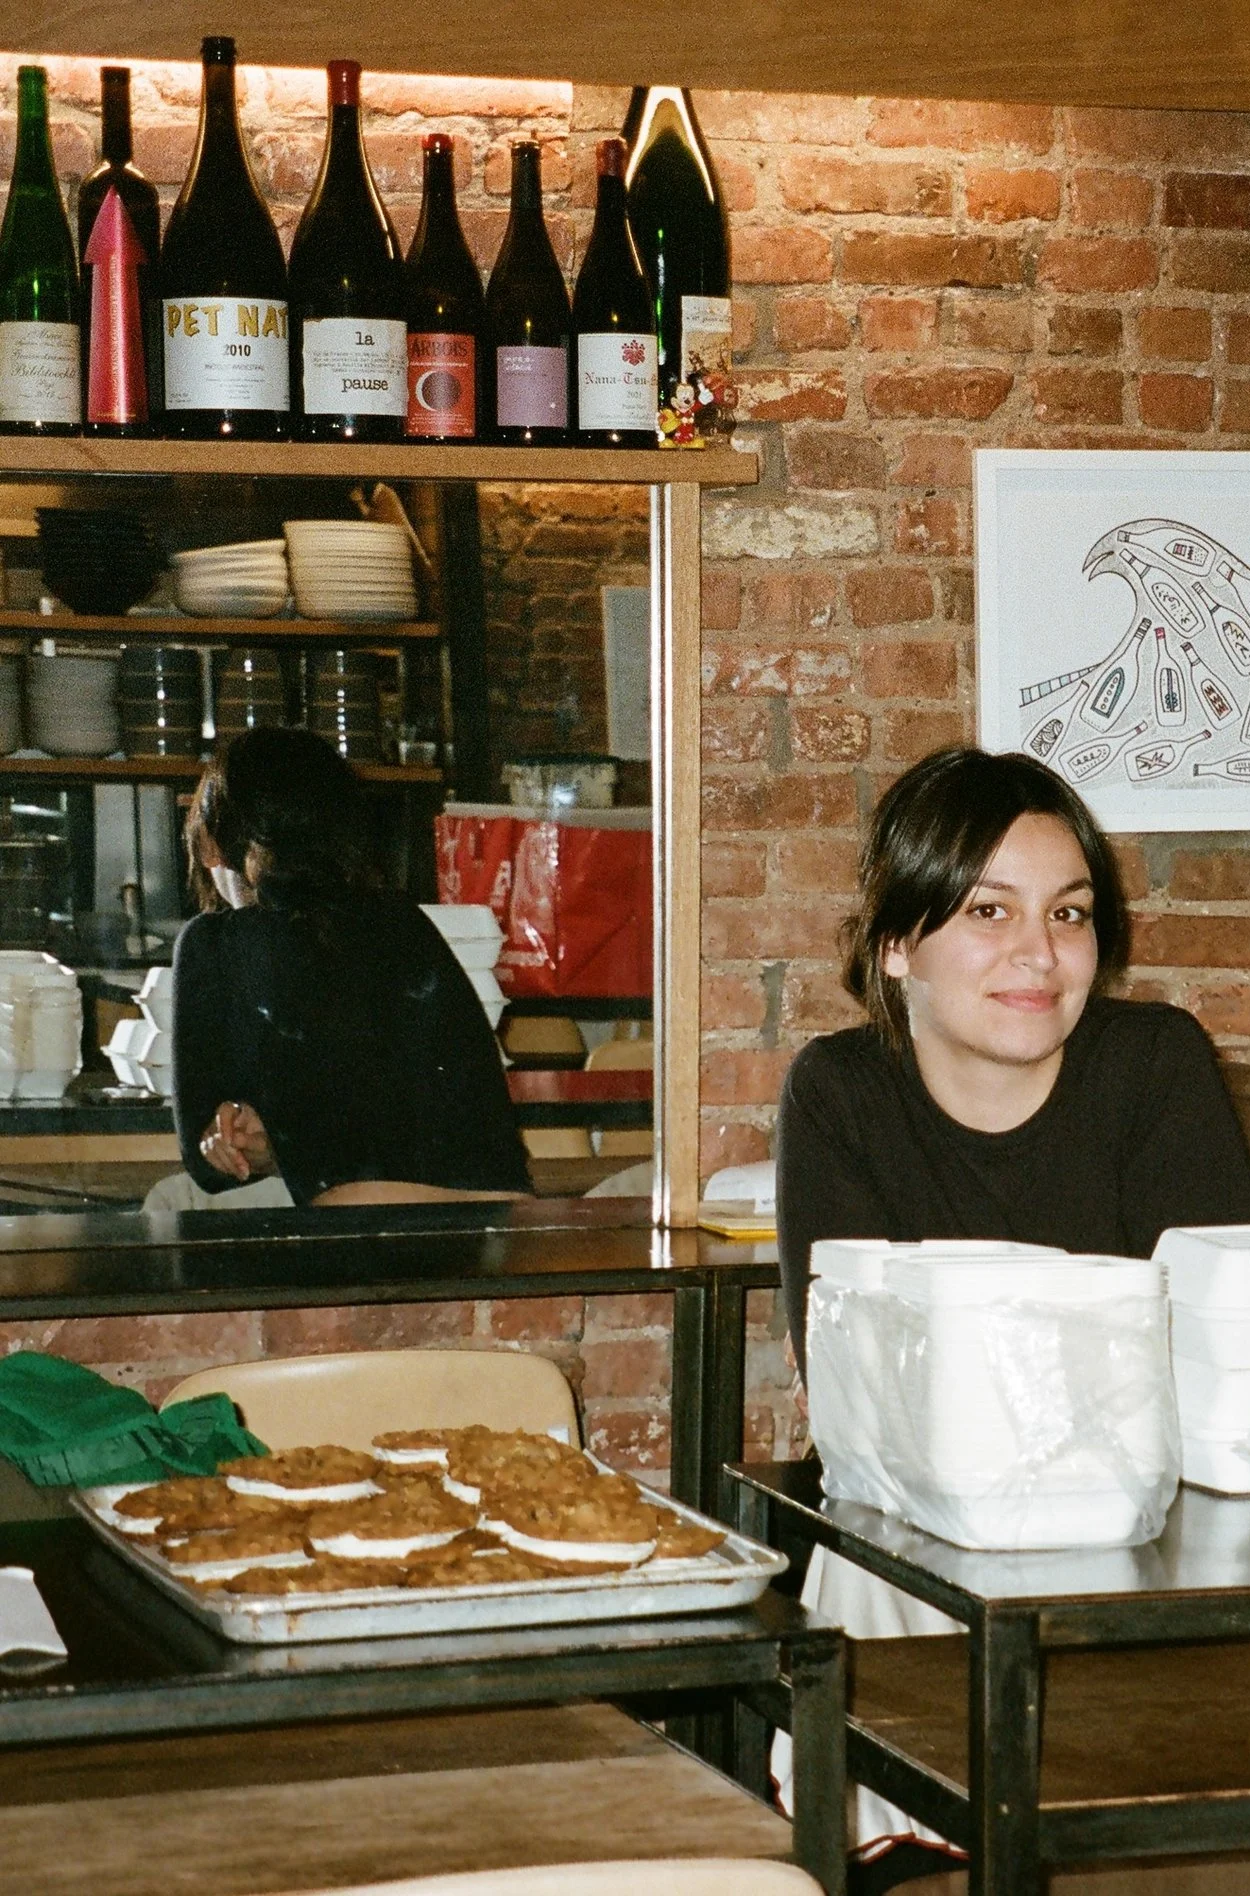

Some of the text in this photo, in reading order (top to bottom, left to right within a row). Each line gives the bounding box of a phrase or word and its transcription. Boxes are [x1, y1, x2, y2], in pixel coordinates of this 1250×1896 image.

[167, 304, 288, 339] PET NAT
[355, 331, 375, 346] la
[224, 344, 251, 357] 2010
[341, 378, 388, 393] pause
